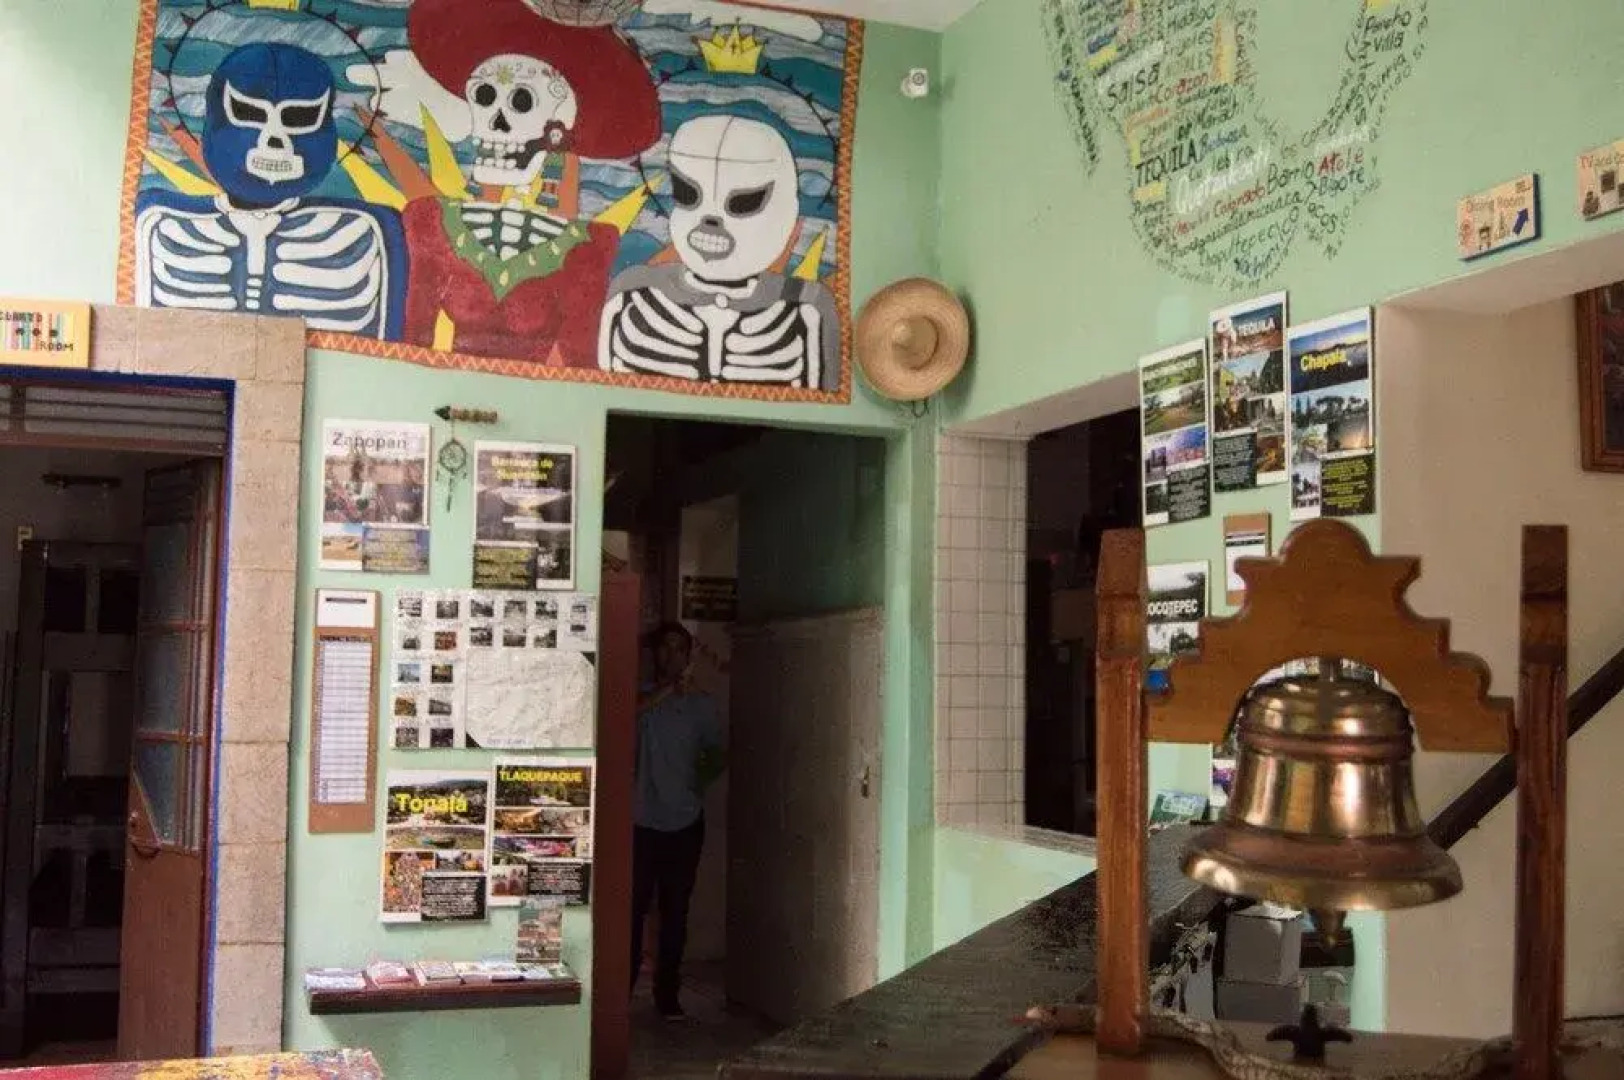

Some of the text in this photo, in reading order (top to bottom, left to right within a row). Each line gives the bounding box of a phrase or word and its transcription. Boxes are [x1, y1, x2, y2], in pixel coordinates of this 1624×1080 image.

[1135, 138, 1201, 188] TEQUILA
[332, 432, 408, 452] Zapopan
[1147, 599, 1198, 616] OCOTEPEC
[499, 770, 583, 782] TLAQUEPAQUE
